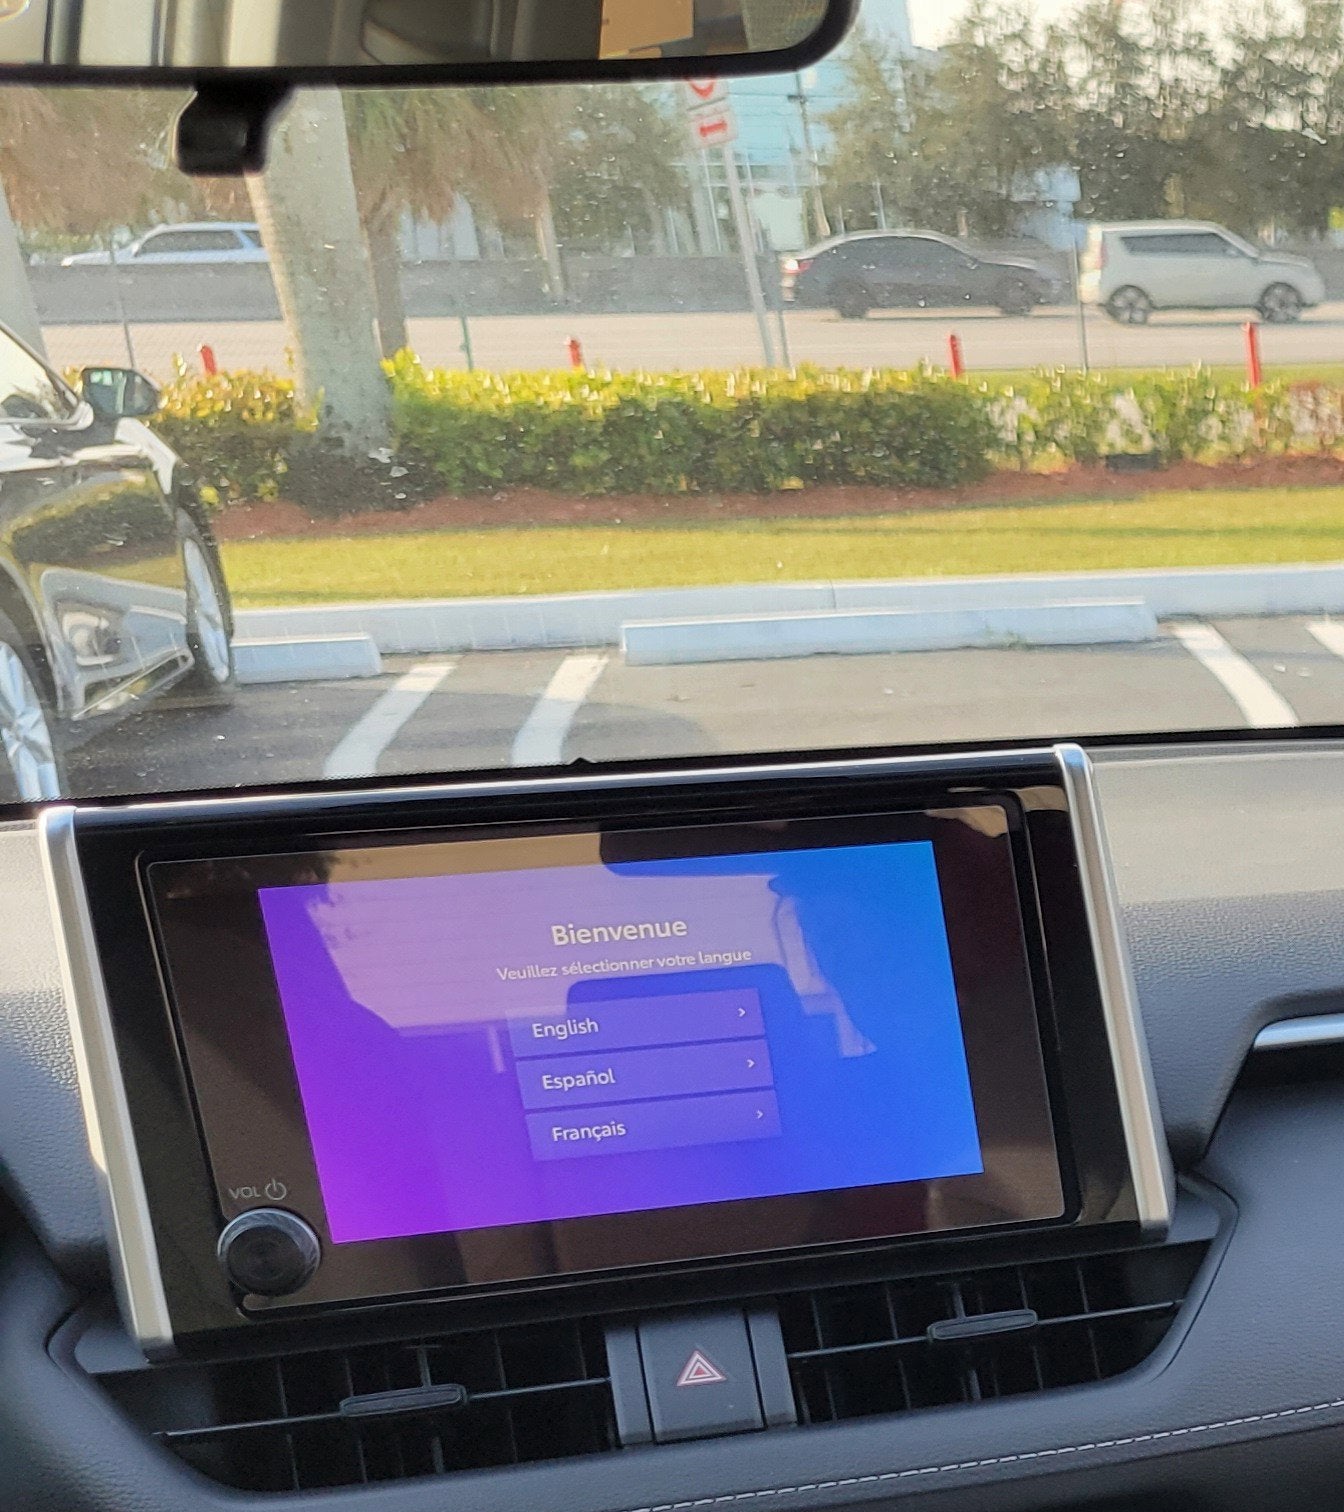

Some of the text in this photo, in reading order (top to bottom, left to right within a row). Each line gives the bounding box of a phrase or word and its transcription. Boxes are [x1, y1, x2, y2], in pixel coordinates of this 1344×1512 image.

[551, 920, 688, 946] Bienvenue
[496, 950, 752, 981] Veuillez sélectionner votre langue
[531, 1018, 599, 1040] English
[541, 1068, 616, 1091] Español
[551, 1121, 627, 1142] Français
[228, 1186, 261, 1199] VOL
